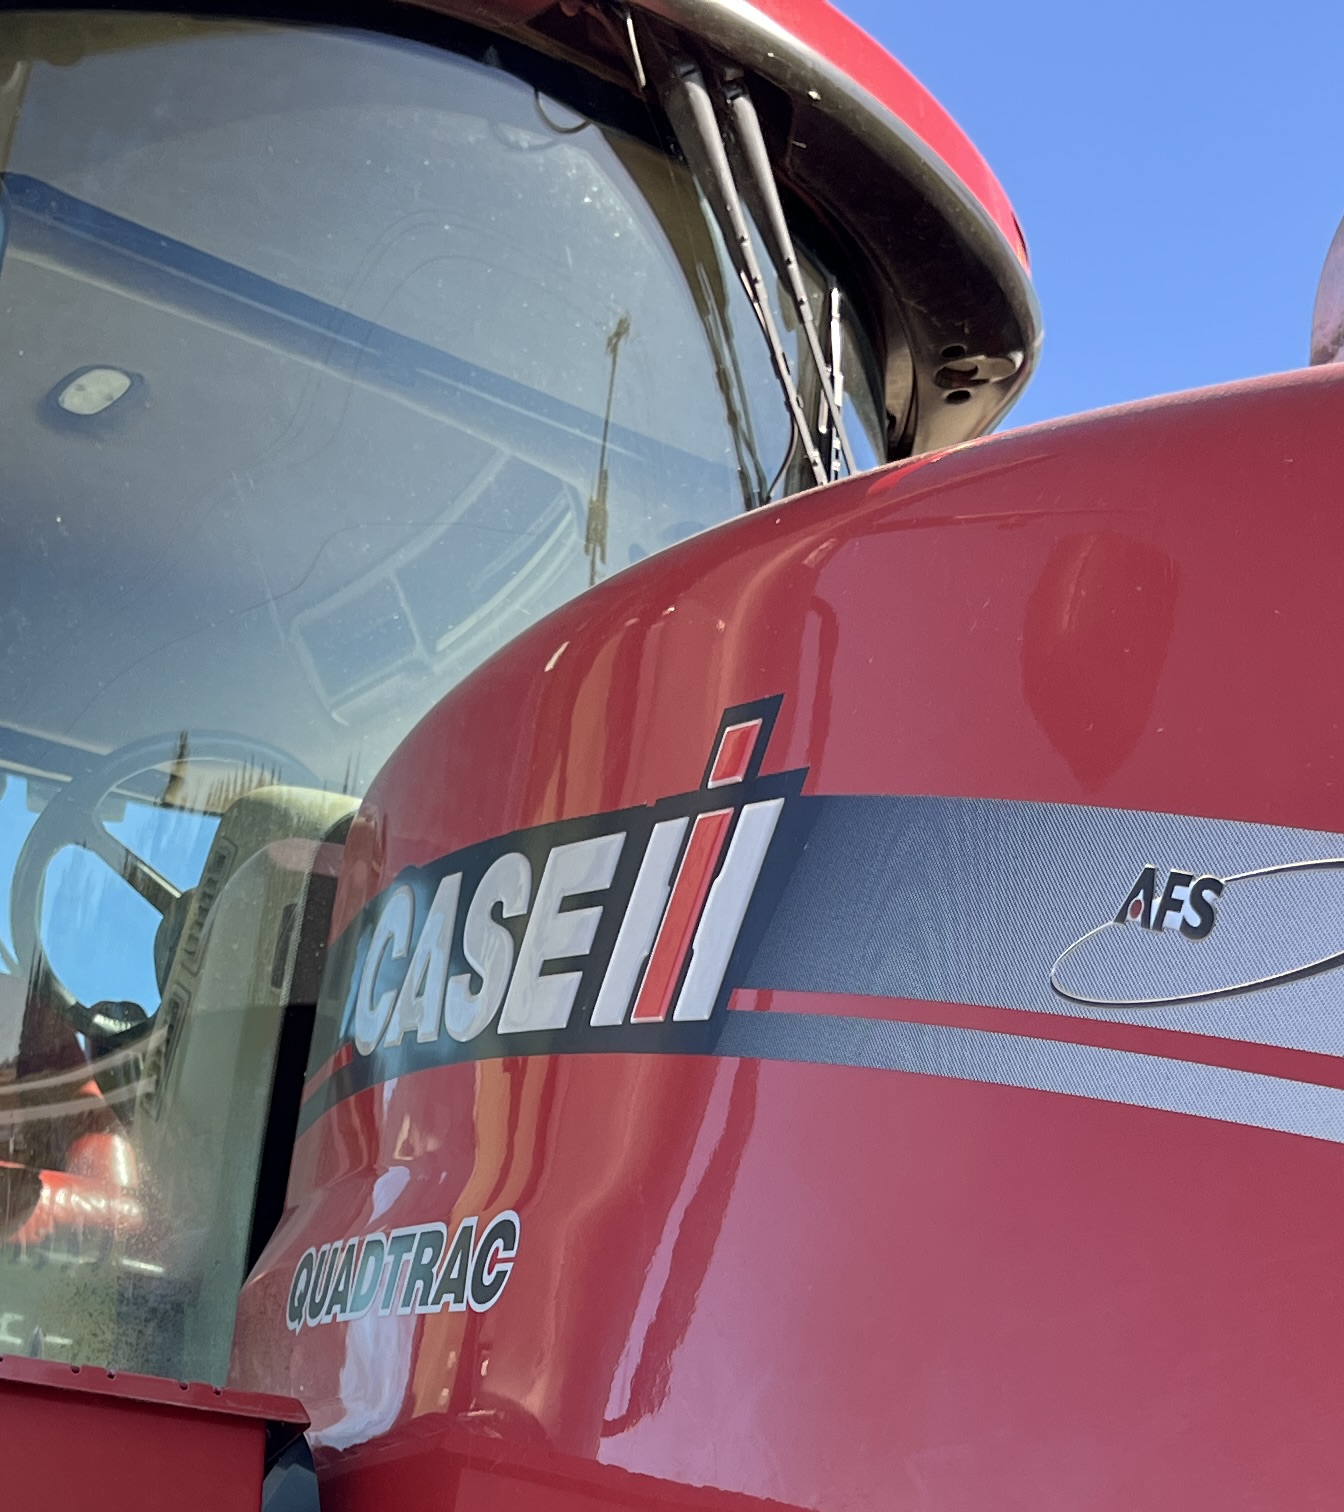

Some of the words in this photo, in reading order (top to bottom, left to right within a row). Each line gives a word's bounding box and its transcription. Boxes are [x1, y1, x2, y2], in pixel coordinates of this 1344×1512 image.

[356, 832, 626, 1056] CASE
[1113, 864, 1225, 941] AFS
[286, 1210, 521, 1335] QUADTRAC
